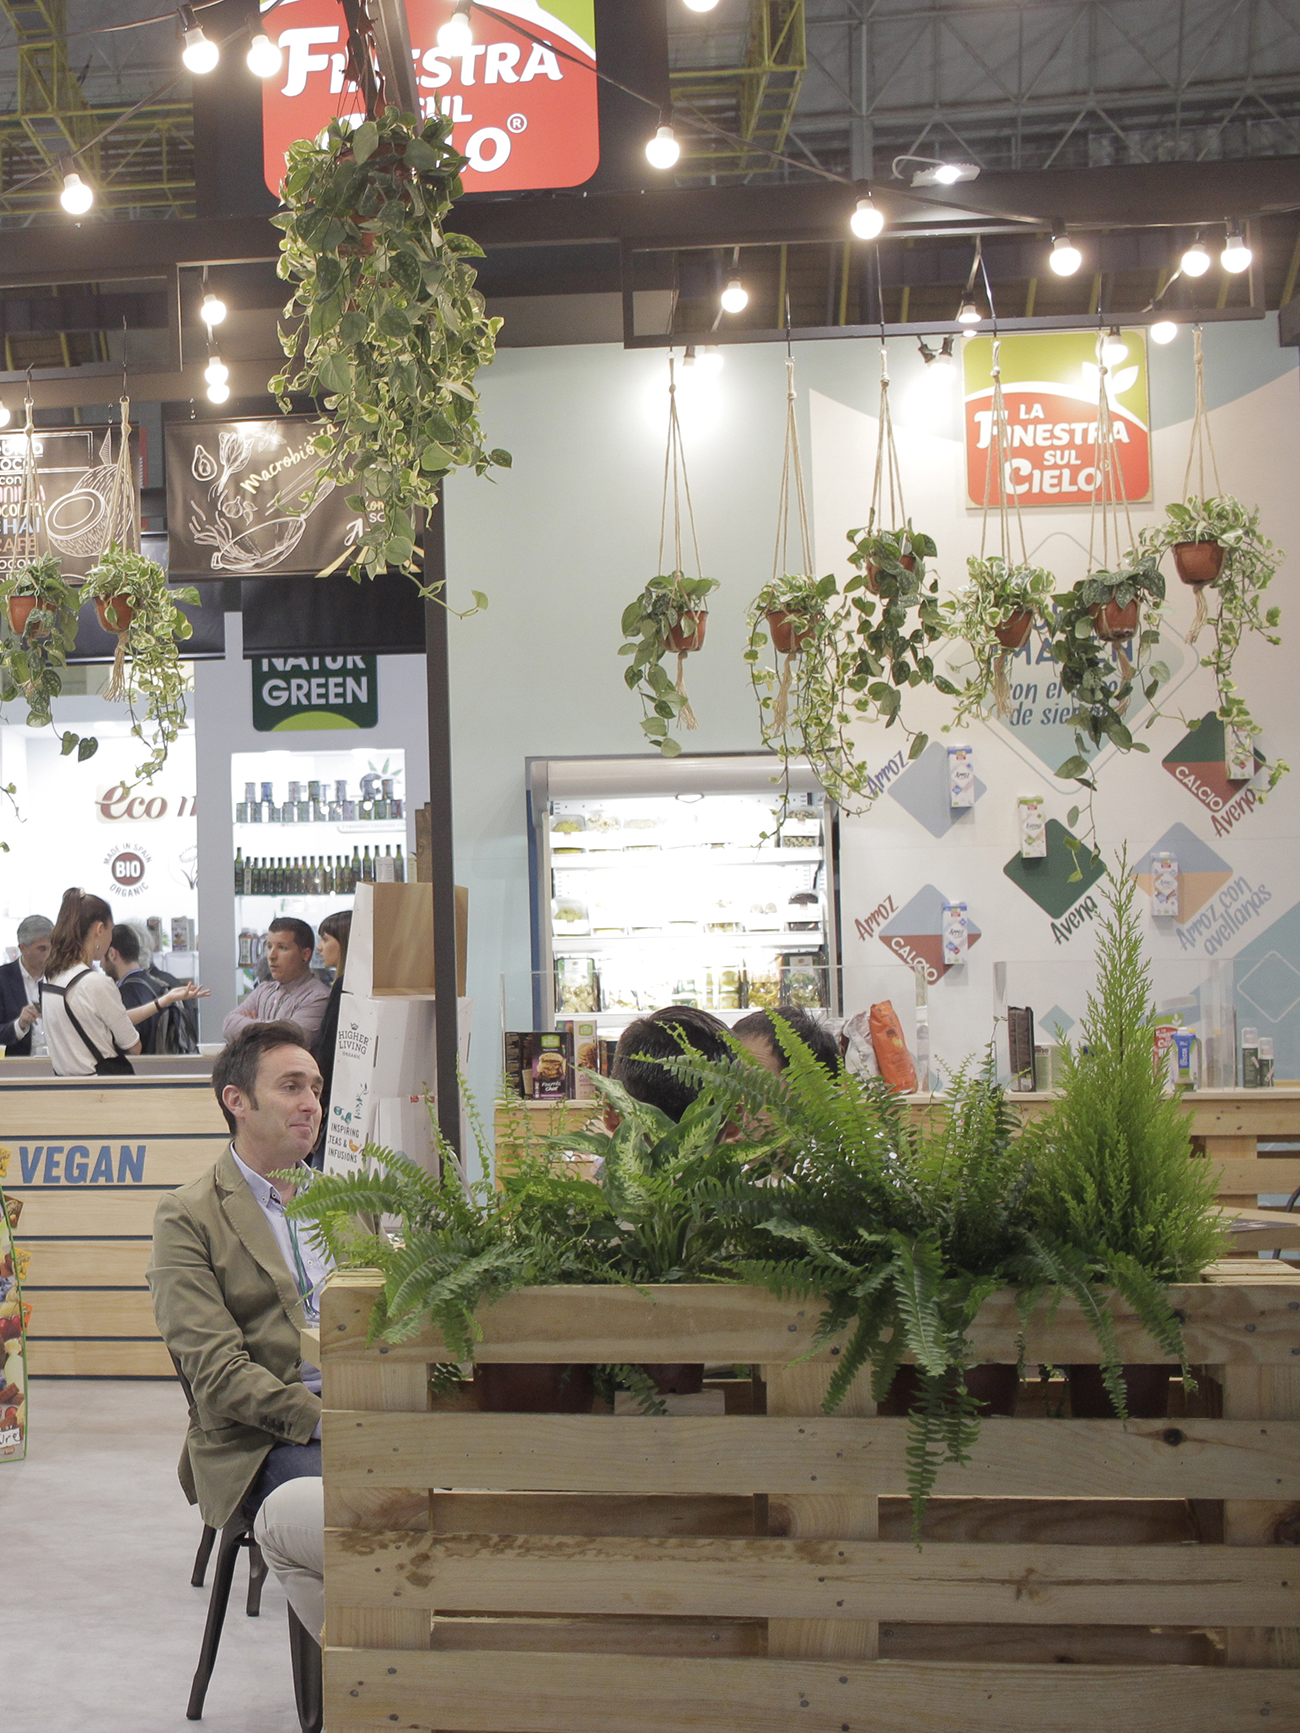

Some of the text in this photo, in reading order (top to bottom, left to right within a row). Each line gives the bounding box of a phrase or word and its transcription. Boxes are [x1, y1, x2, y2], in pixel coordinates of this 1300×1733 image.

[278, 25, 564, 98] FISTRA
[1019, 403, 1044, 419] LA
[973, 410, 1130, 450] FINESTRA
[1043, 450, 1081, 466] SUL
[261, 676, 368, 707] GREEN
[1010, 681, 1038, 704] on
[1046, 679, 1062, 699] el
[1009, 701, 1033, 726] de
[866, 750, 909, 797] Arroz
[1175, 765, 1223, 811] CALCIO
[103, 842, 152, 866] MADE IN SPAIN
[115, 860, 141, 878] BIO
[109, 881, 150, 898] ORGANIC
[1218, 875, 1253, 912] con
[854, 894, 899, 942] Arroz
[1050, 895, 1098, 945] Avena
[1203, 884, 1272, 956] avellanas
[891, 937, 938, 982] CALCO
[338, 1030, 369, 1046] HIGHER
[338, 1040, 367, 1055] LIVING
[329, 1135, 342, 1146] TEAS
[331, 1123, 359, 1138] INSPIRING
[19, 1144, 146, 1184] VEGAN
[328, 1148, 358, 1164] INFUSIONS
